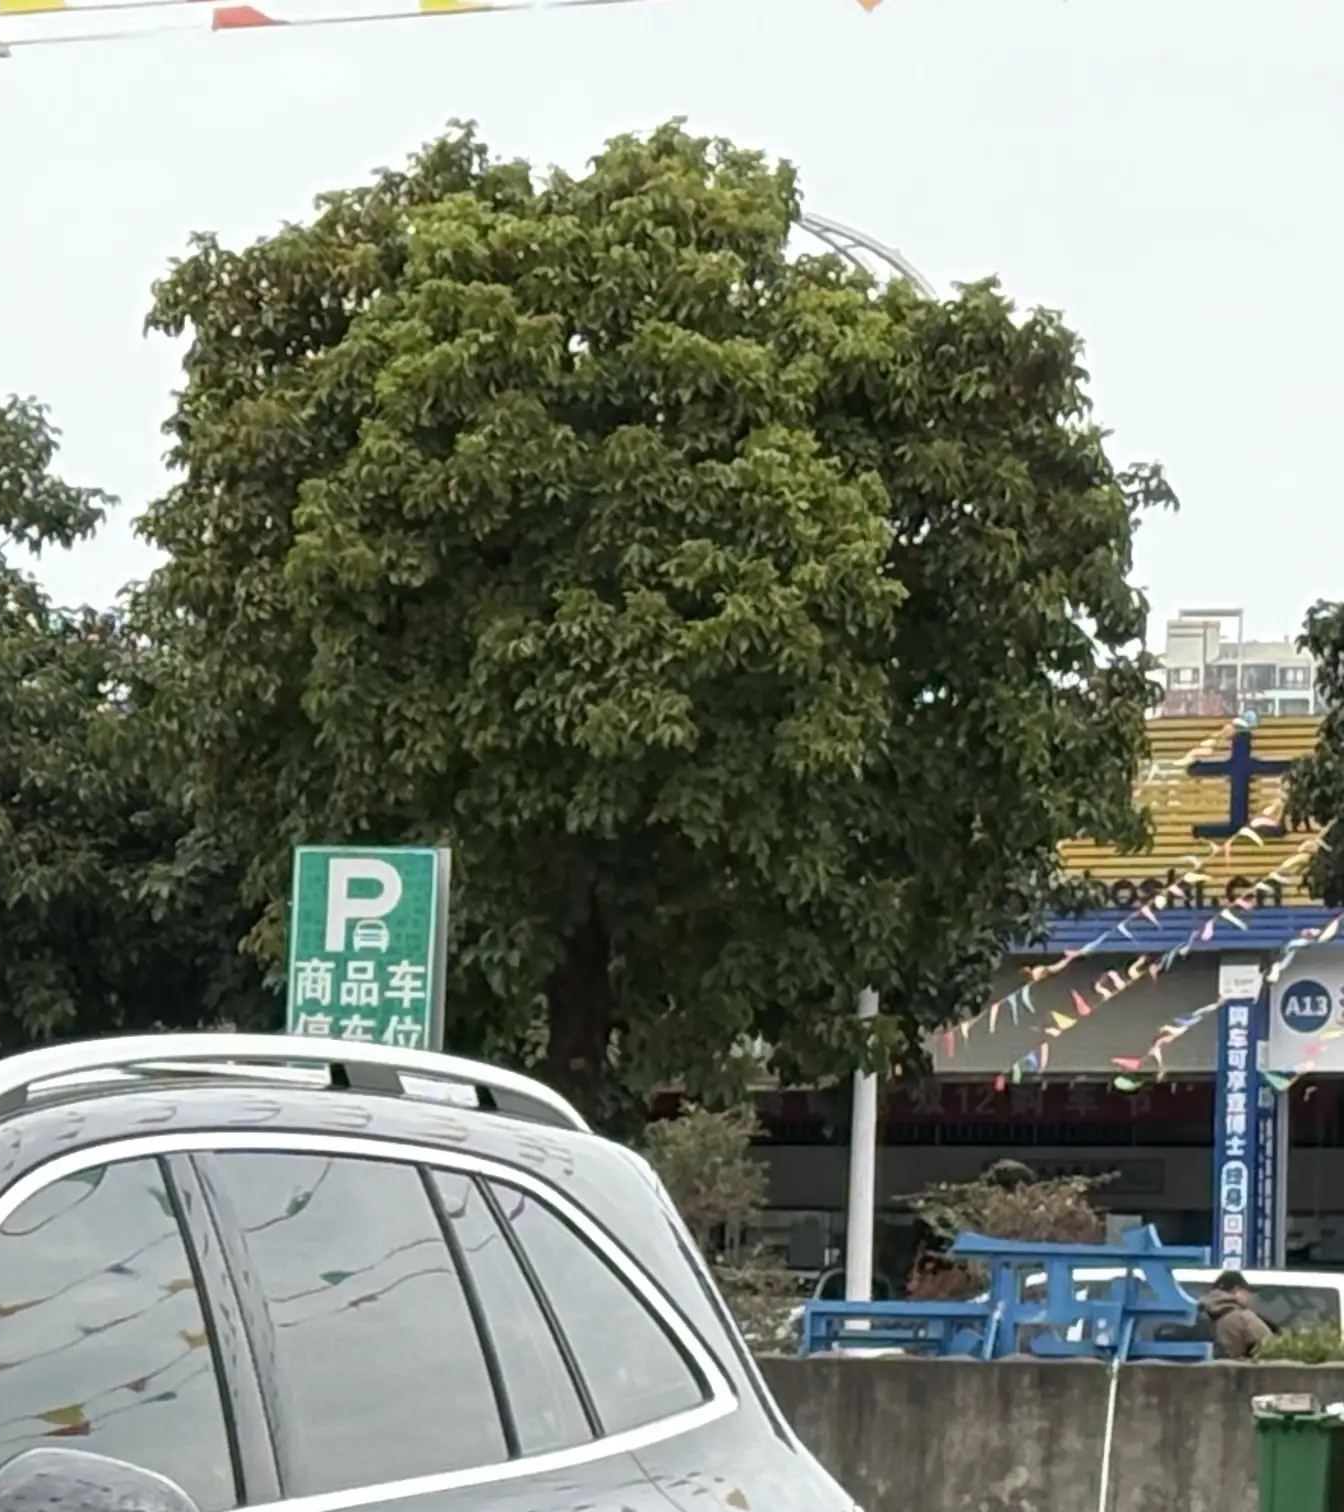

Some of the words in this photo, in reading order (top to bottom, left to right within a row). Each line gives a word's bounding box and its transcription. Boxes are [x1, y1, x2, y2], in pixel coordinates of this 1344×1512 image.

[324, 858, 403, 953] P
[295, 957, 426, 1009] 商品车
[1285, 995, 1328, 1017] A13
